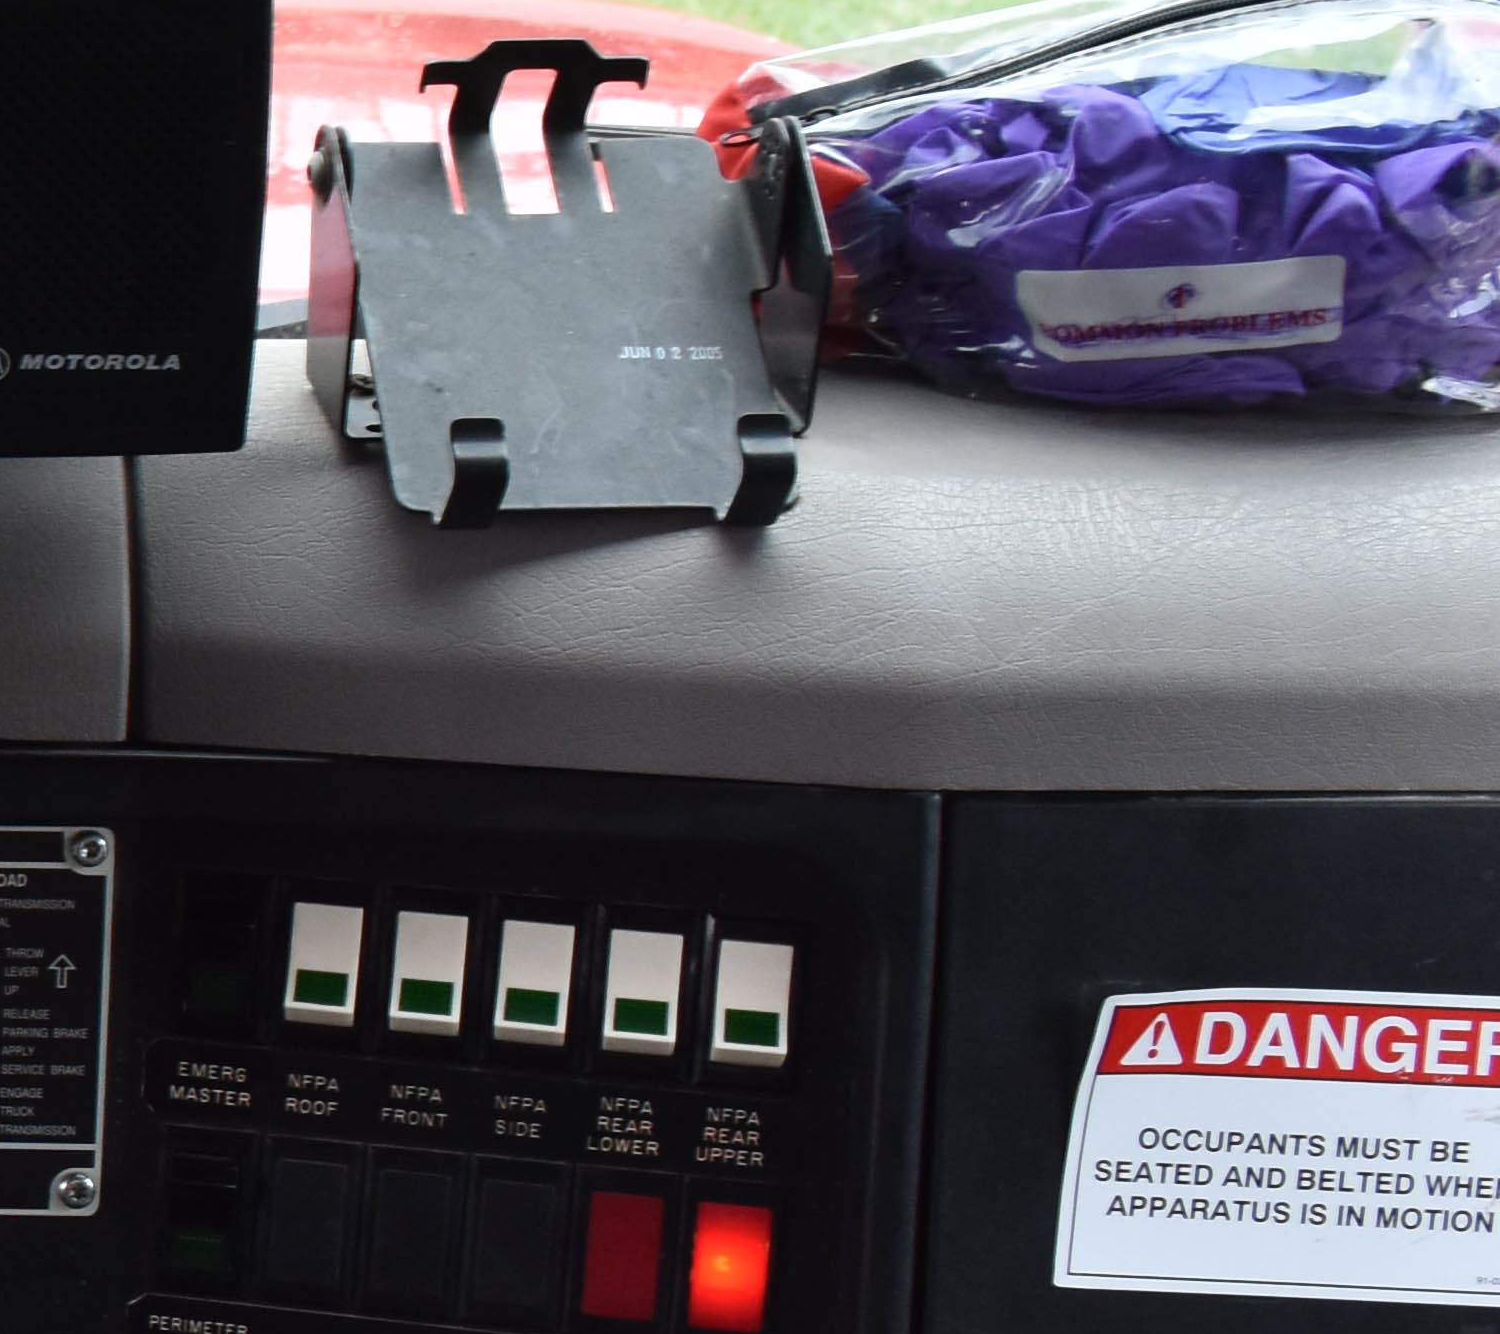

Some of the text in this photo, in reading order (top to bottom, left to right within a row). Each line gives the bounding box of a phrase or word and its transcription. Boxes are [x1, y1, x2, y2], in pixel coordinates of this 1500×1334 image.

[19, 354, 181, 370] MOTOROLA
[618, 346, 651, 359] JUN
[178, 1061, 247, 1083] EMERG
[287, 1073, 340, 1092] NFPA
[169, 1084, 251, 1108] MASTER
[390, 1084, 443, 1103] NFPA
[285, 1097, 339, 1116] ROOF
[494, 1095, 547, 1114] NFPA
[599, 1096, 655, 1115] NFPA
[380, 1107, 448, 1128] FRONT
[597, 1116, 653, 1135] REAR
[706, 1107, 761, 1126] NFPA
[494, 1119, 541, 1139] SIDE
[703, 1126, 760, 1146] REAR
[587, 1136, 660, 1156] LOWER
[1138, 1127, 1471, 1163] OCCUPANTS MUST BE
[696, 1146, 764, 1166] UPPER
[1094, 1160, 1500, 1199] SEATED AND BELTED WHE
[1106, 1195, 1495, 1233] APPARATUS IS IN MOTION
